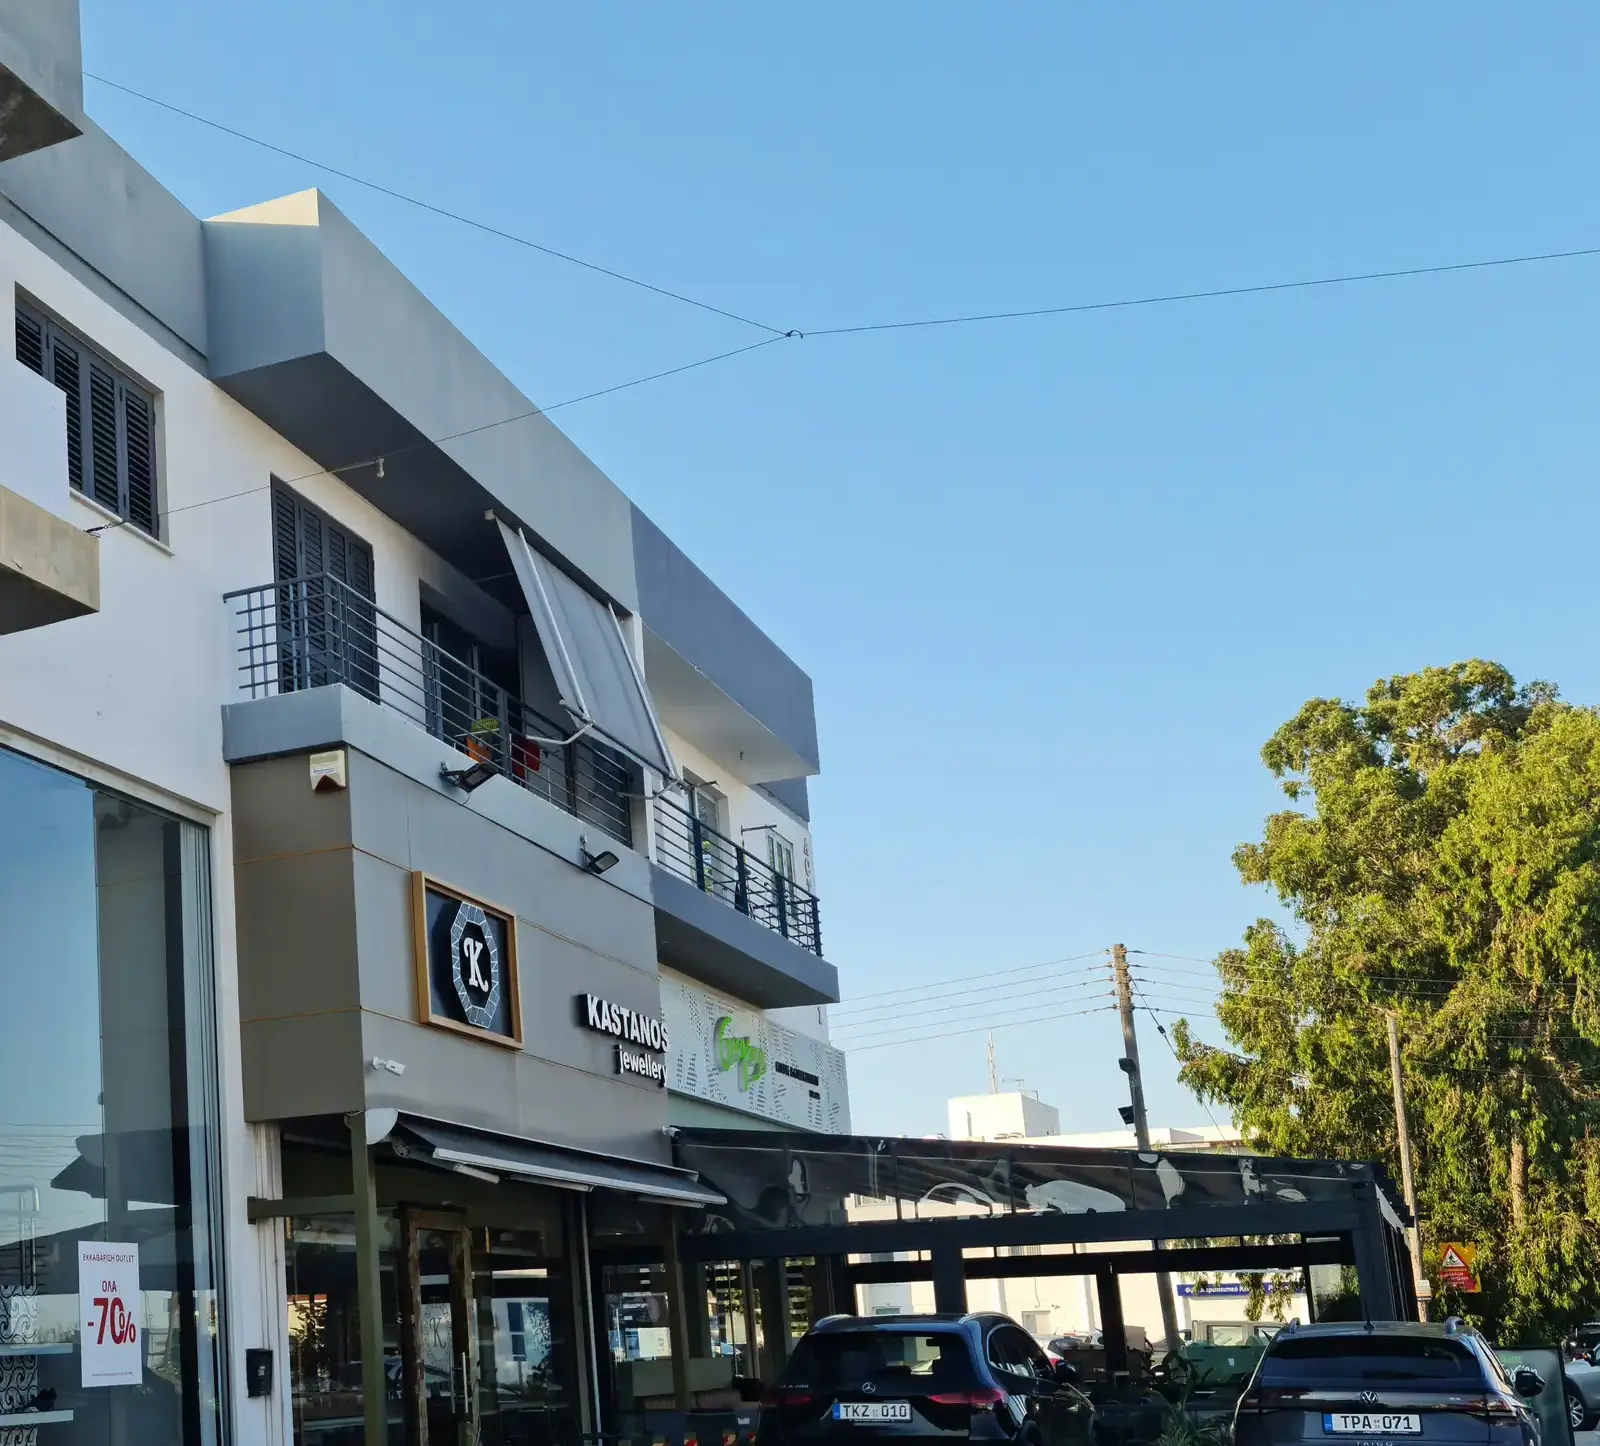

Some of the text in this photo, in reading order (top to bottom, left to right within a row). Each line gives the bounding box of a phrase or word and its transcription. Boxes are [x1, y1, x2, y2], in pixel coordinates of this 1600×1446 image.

[463, 937, 488, 992] K
[583, 993, 670, 1052] KASTANOS
[618, 1044, 668, 1087] jewellery
[116, 1255, 135, 1263] OUTLET
[88, 1297, 136, 1344] -70%
[842, 1404, 870, 1417] TKZ
[881, 1404, 907, 1417] 010
[1340, 1415, 1372, 1429] TPA
[1382, 1415, 1413, 1430] 071
